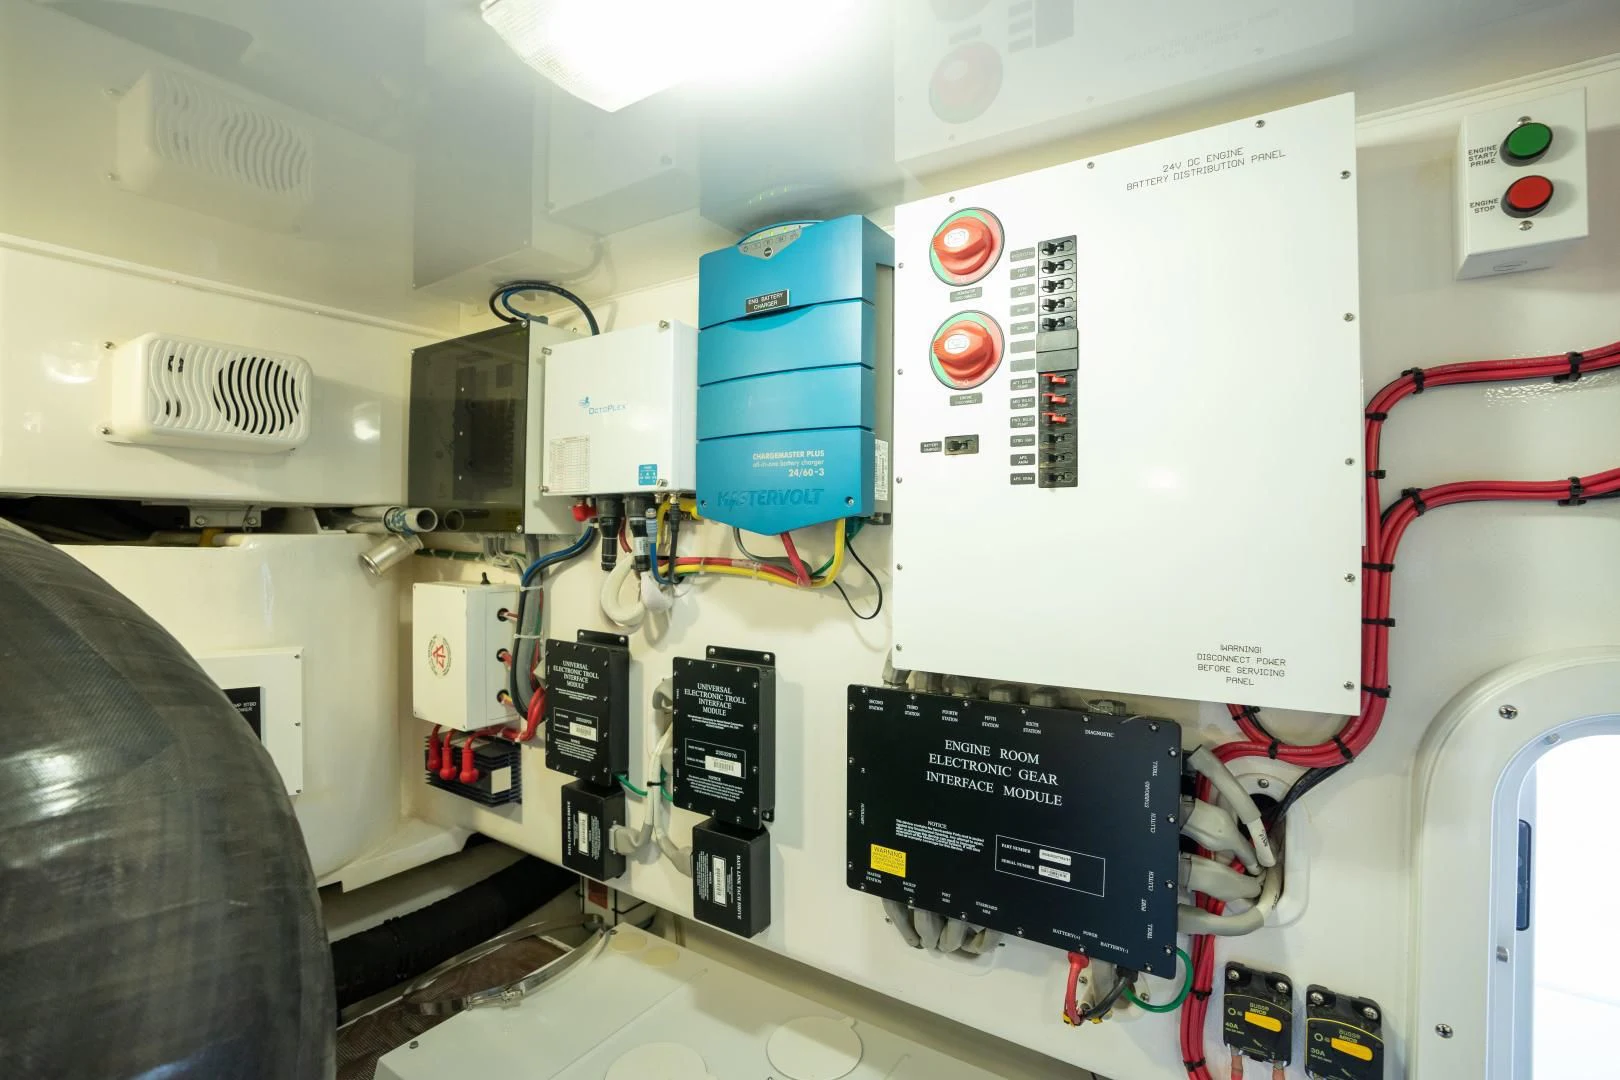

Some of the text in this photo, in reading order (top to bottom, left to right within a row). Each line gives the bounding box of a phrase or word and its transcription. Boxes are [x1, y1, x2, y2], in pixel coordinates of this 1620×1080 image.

[1468, 144, 1498, 156] ENGINE
[1162, 147, 1245, 173] 24V DC ENGINE
[1468, 151, 1498, 162] START/
[1470, 158, 1496, 168] PRIME
[1126, 149, 1287, 191] BATTERY DISTRIBUTION PANEL
[1469, 197, 1499, 208] ENGINE
[1474, 205, 1496, 214] STOP
[760, 292, 784, 302] BATTERY
[753, 300, 778, 310] CHARGER
[752, 449, 825, 460] CHARGEMASTER PLUS
[801, 459, 825, 467] charger
[788, 468, 825, 477] 24/60-3
[1220, 644, 1262, 654] WARNING!
[1197, 653, 1286, 666] DISCONNECT POWER
[562, 660, 589, 671] UNIVERSAL
[1197, 663, 1285, 677] BEFORE SERVICING
[553, 665, 599, 679] ELECTRONIC TROLL
[563, 673, 589, 684] INTERFACE
[1226, 676, 1255, 686] PANEL
[566, 680, 585, 689] MODULE
[697, 682, 732, 694] UNIVERSAL
[684, 688, 747, 705] ELECTRONIC TROLL
[698, 698, 732, 709] INTERFACE
[702, 706, 727, 716] MODULE
[1084, 729, 1114, 738] DIAGNOSTIC
[945, 739, 1040, 765] ENGINE ROOM
[928, 752, 1059, 786] ELECTRONIC GEAR
[926, 770, 1063, 807] INTERFACE MODULE
[927, 820, 948, 829] NOTICE
[873, 846, 903, 859] WARNING
[1225, 1021, 1239, 1030] 40A
